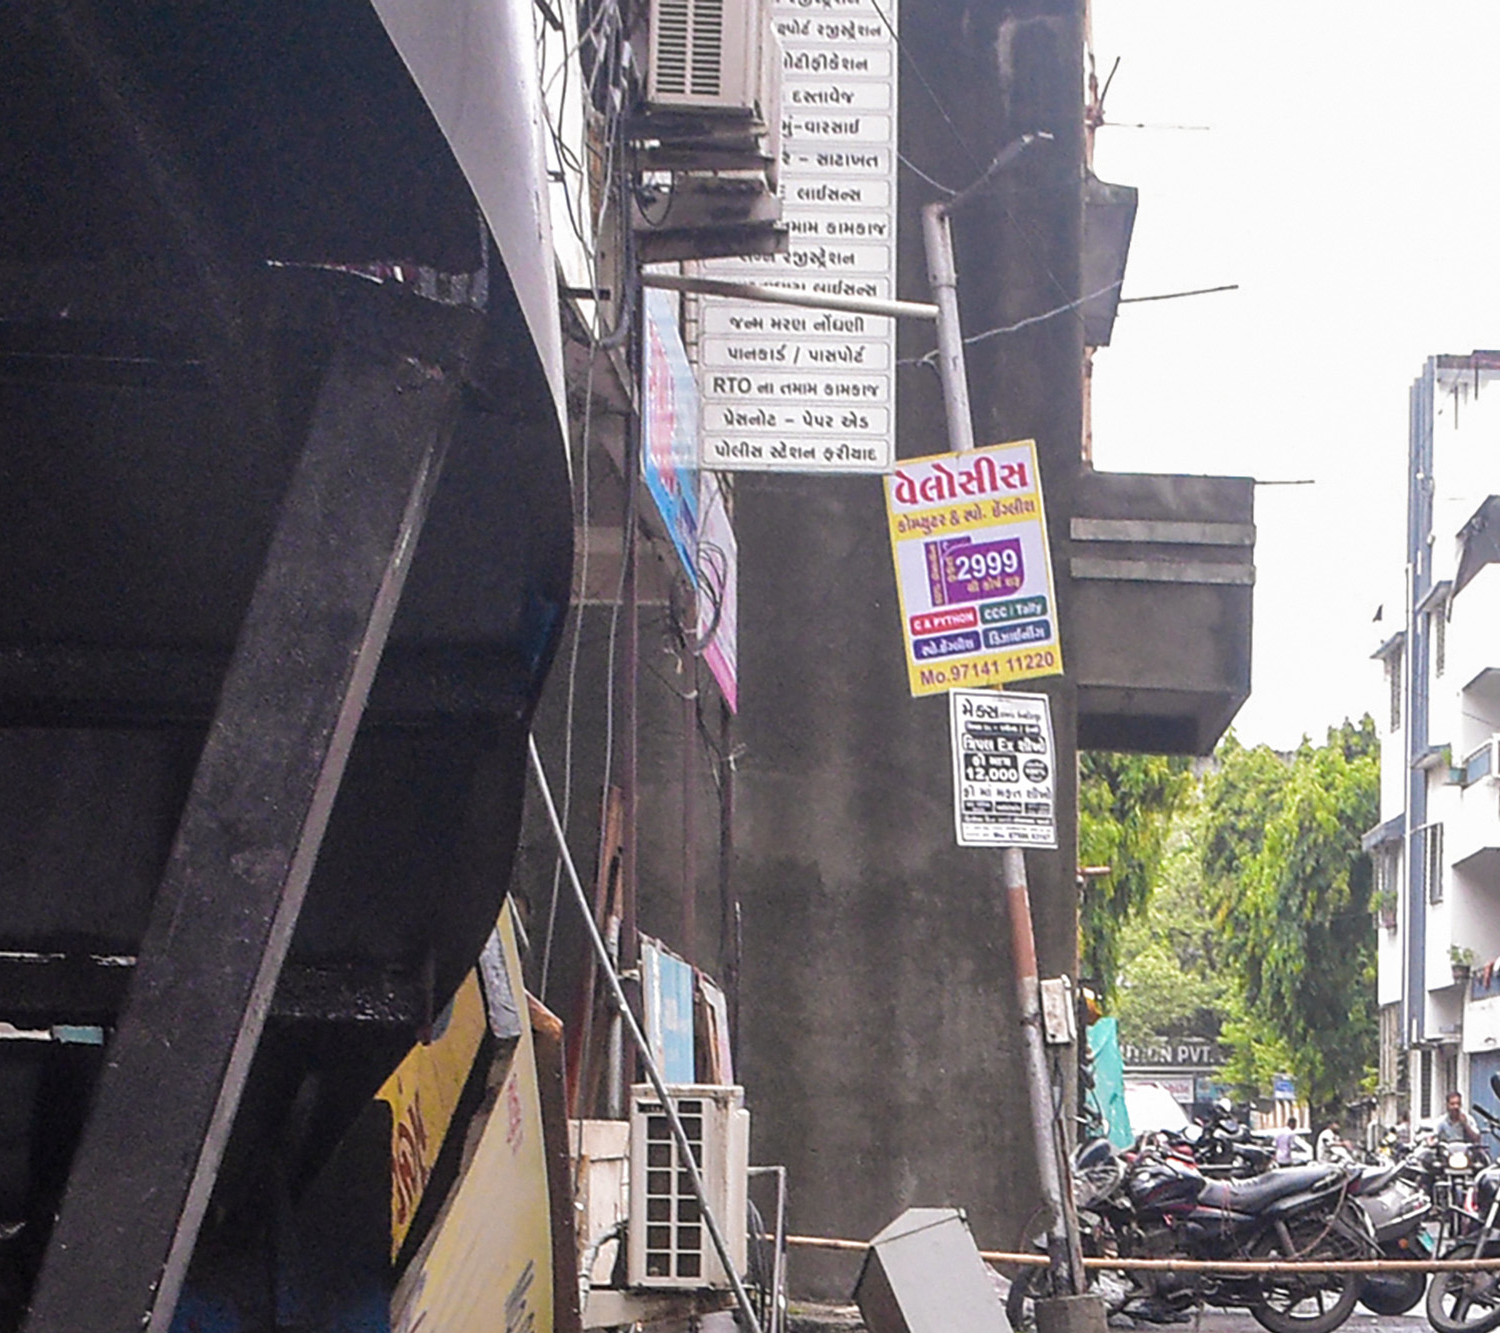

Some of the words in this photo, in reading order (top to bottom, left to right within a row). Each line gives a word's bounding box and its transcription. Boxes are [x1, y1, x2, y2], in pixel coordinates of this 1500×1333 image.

[770, 317, 806, 331] મરણ
[713, 376, 752, 394] RTO
[715, 440, 763, 459] પોલીસ
[894, 456, 1029, 505] વેલોસીસ
[954, 549, 1019, 581] 2999
[984, 608, 1007, 620] CCC
[920, 661, 1000, 686] Mo.97141
[1006, 651, 1055, 672] 11220
[966, 767, 1019, 781] 12,000
[1177, 1044, 1215, 1063] PVT.
